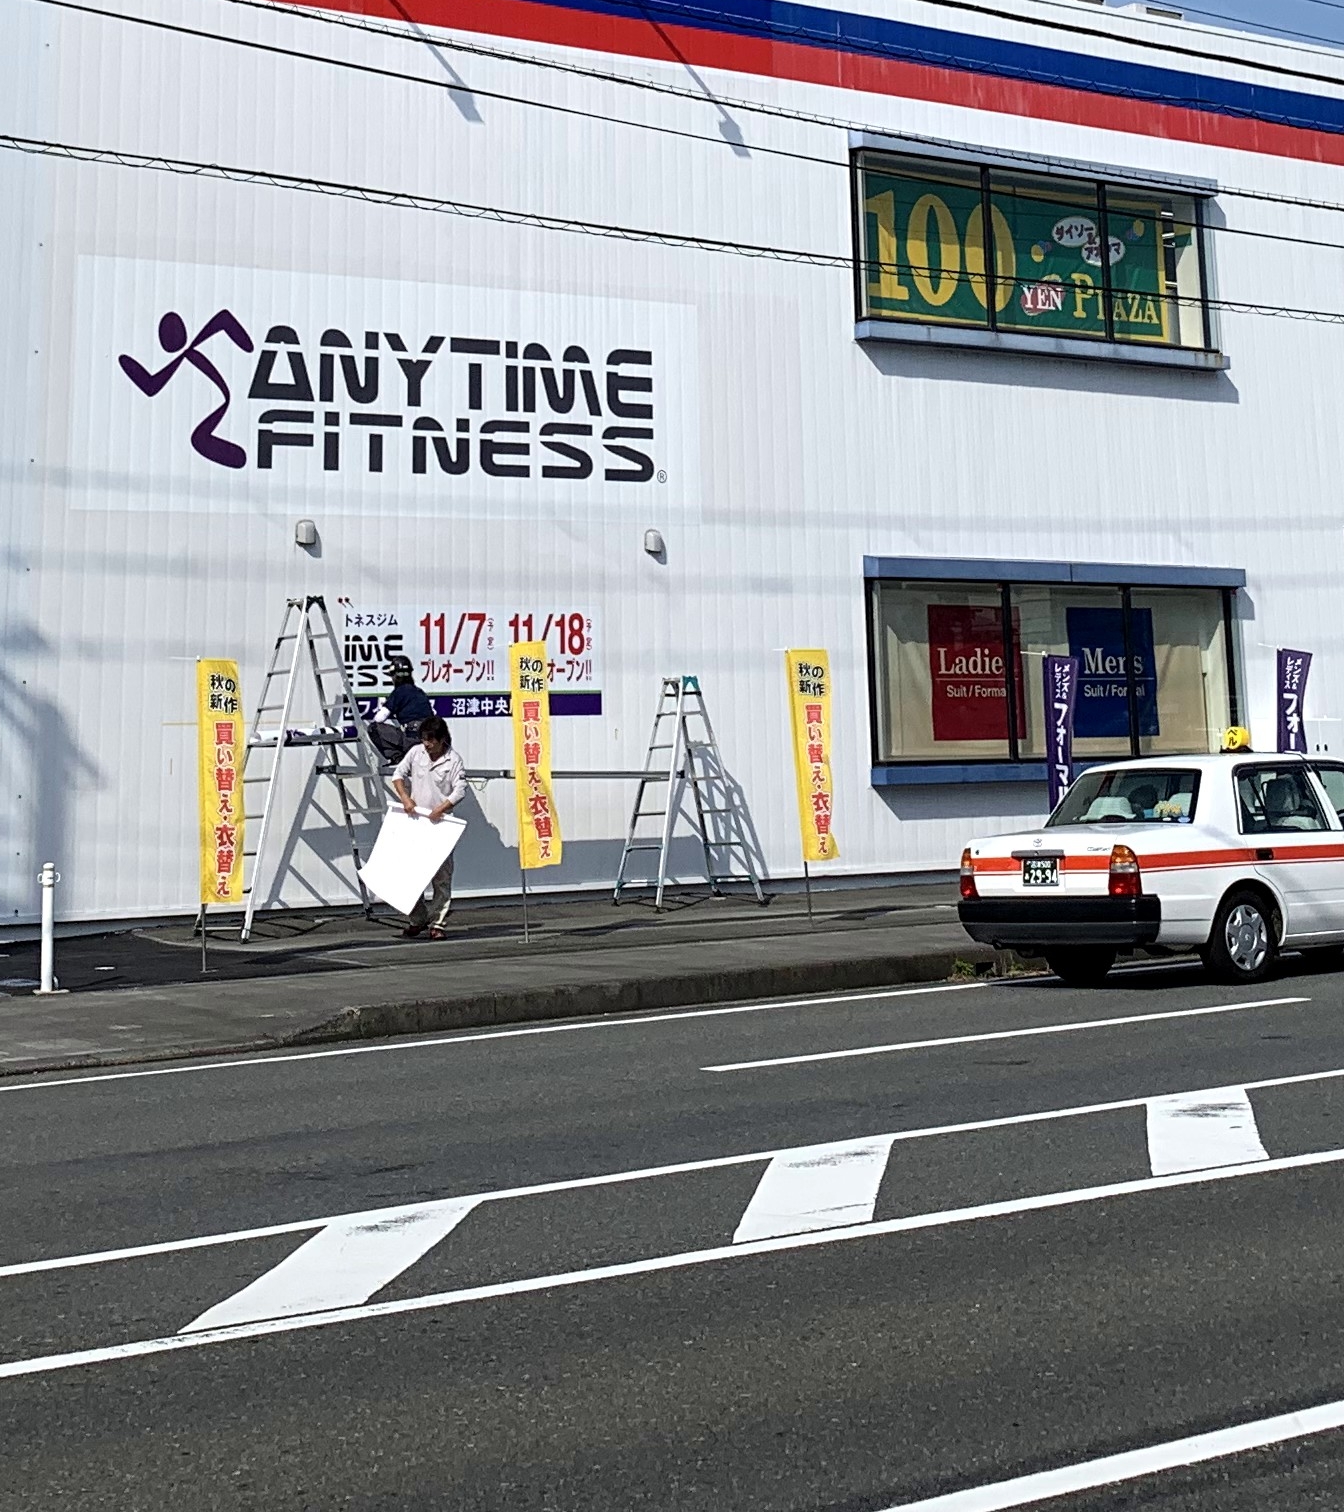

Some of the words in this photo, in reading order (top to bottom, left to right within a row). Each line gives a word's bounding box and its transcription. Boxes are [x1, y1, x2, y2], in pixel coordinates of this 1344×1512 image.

[865, 190, 1016, 312] 100
[1022, 284, 1063, 311] YEN
[248, 325, 653, 420] ANYTIME
[257, 408, 654, 483] FITNESS
[420, 612, 486, 655] 11/7
[509, 612, 585, 656] 11/18
[520, 657, 543, 675] 秋の
[937, 648, 1004, 675] Ladie
[798, 663, 824, 679] 秋の
[210, 674, 236, 692] 秋の
[520, 675, 544, 692] 新作
[799, 679, 825, 697] 新作
[946, 685, 967, 698] Suit
[1084, 684, 1104, 698] Suit
[1112, 684, 1145, 697] Foral
[209, 693, 238, 714] 新作
[452, 698, 512, 716] 沼津中央
[1228, 729, 1237, 746] ベル
